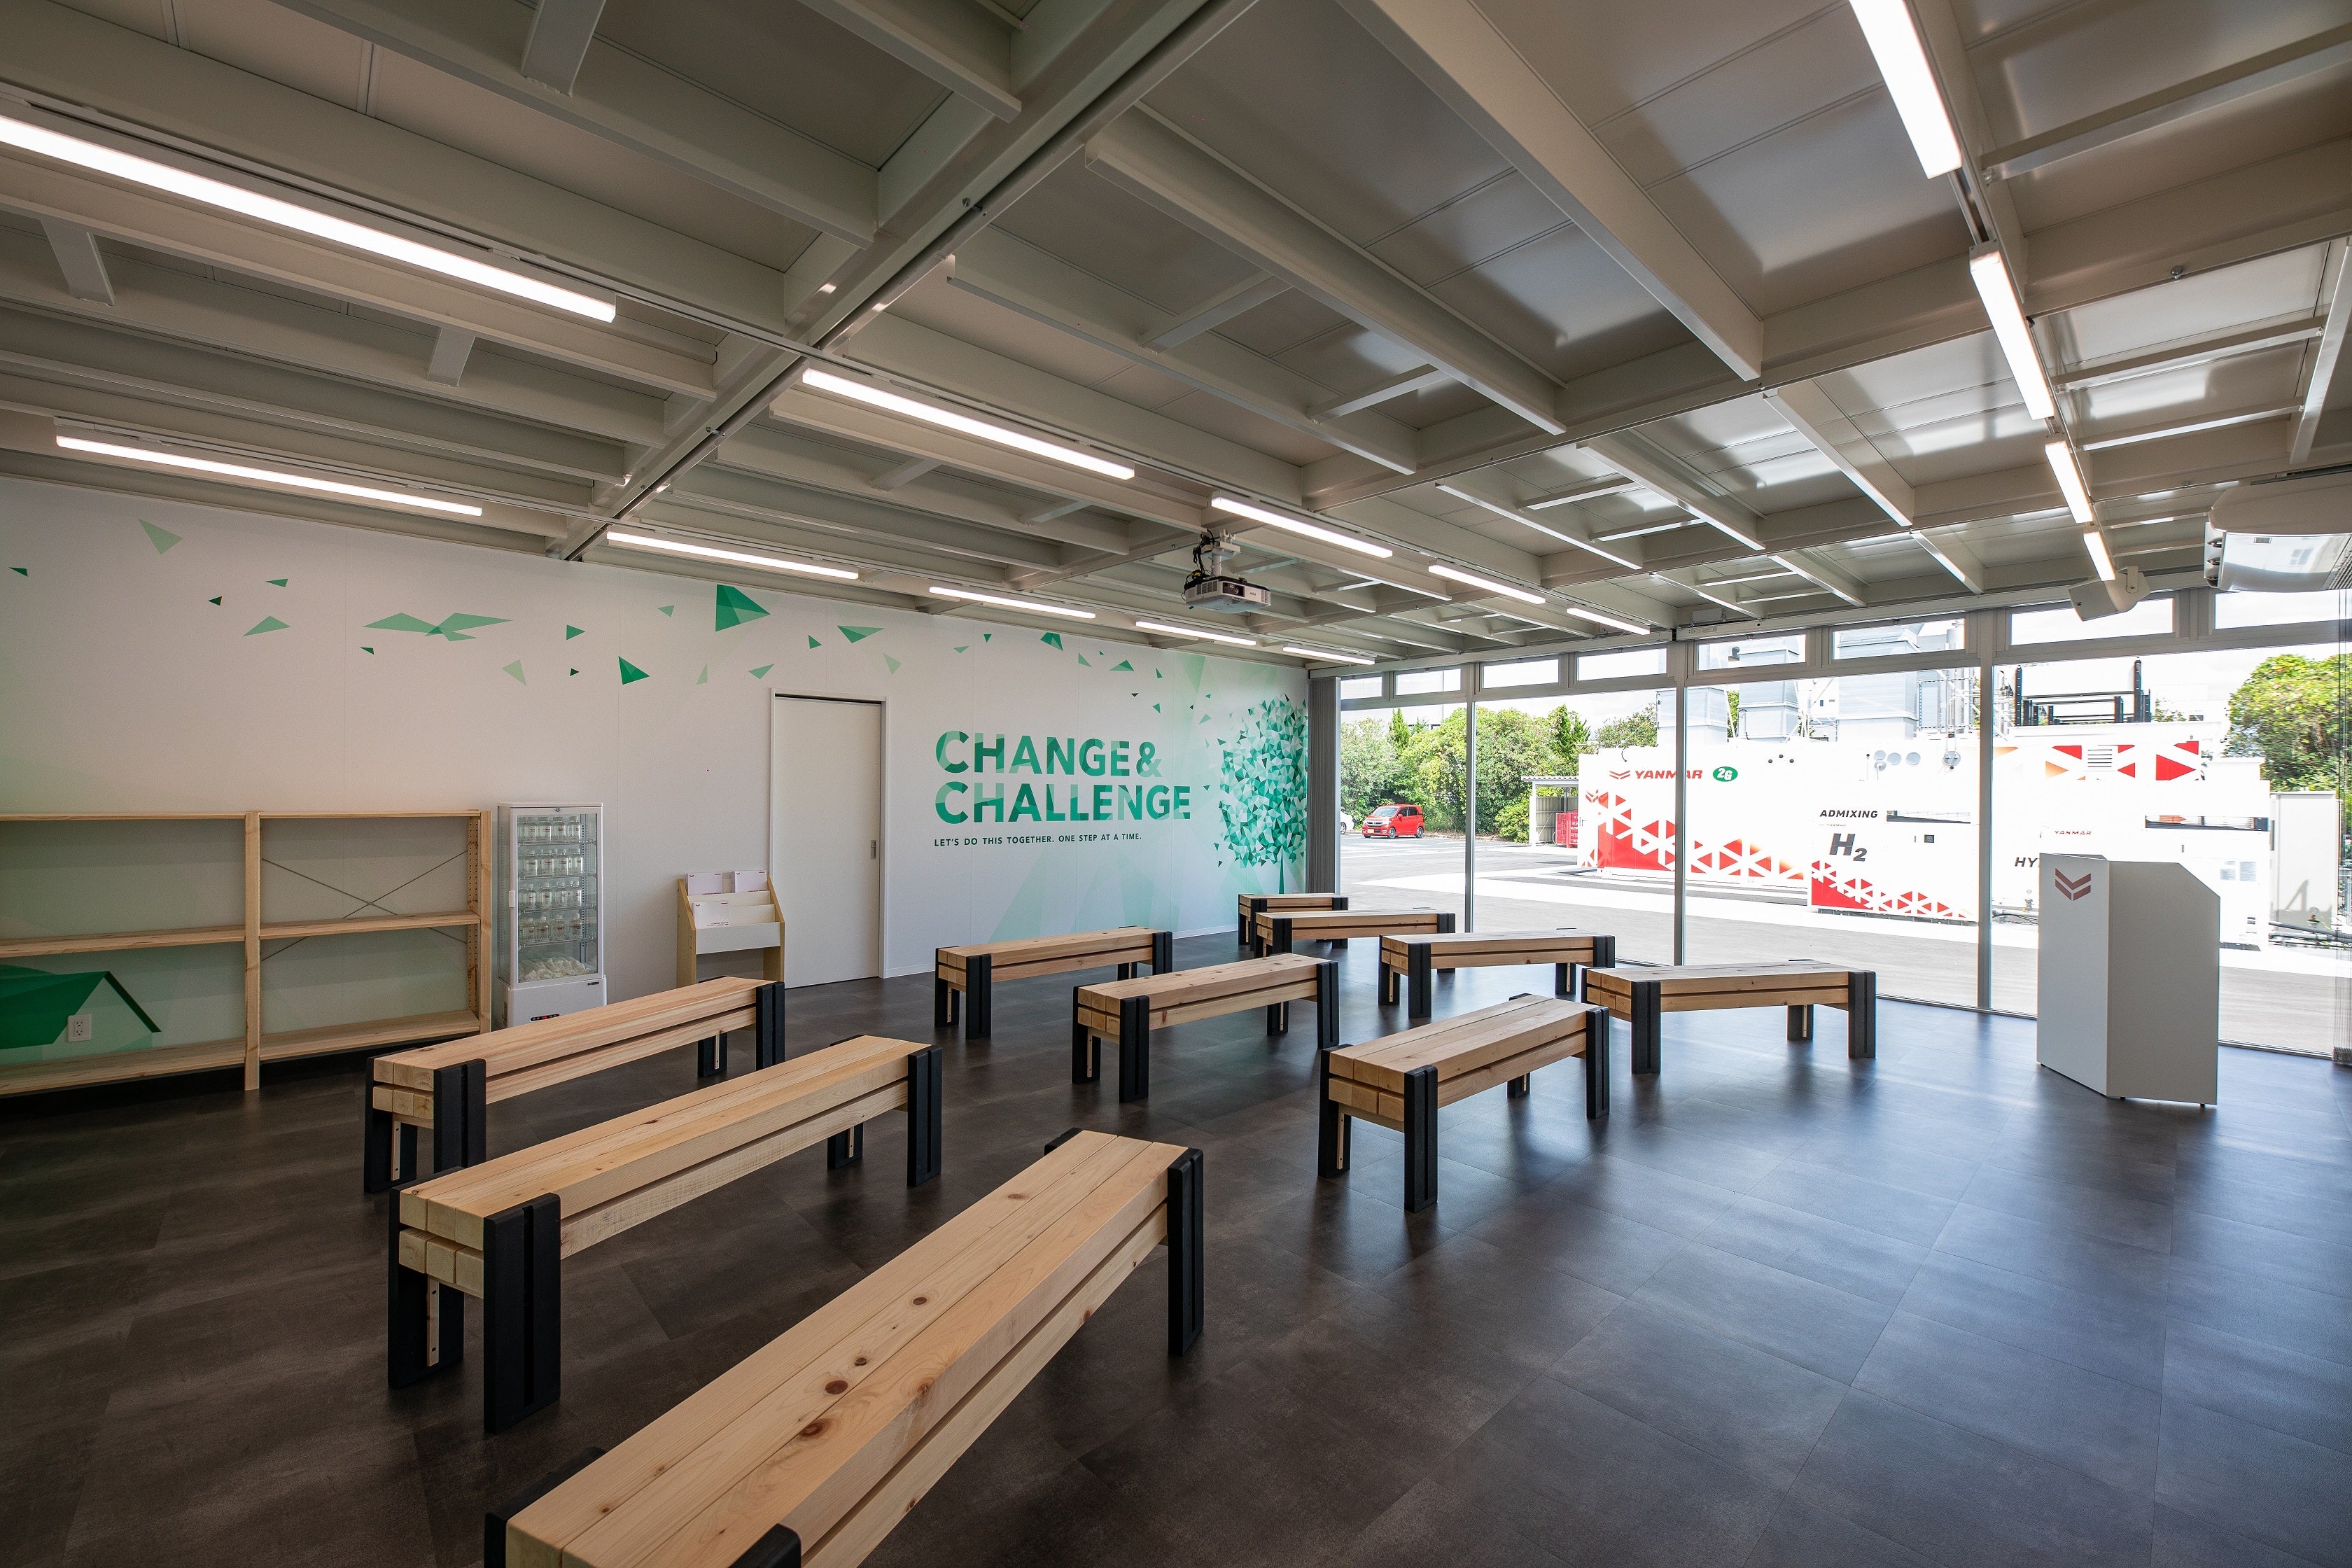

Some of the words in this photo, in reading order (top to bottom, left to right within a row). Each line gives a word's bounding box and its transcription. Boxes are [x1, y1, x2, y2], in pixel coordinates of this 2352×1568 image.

[934, 780, 1191, 825] CHALLENGE
[1819, 809, 1878, 818] ADMIXING
[934, 838, 959, 847] LET'S
[963, 837, 978, 846] DO
[982, 836, 1002, 845] THIS
[1007, 836, 1055, 844] TOGETHER.
